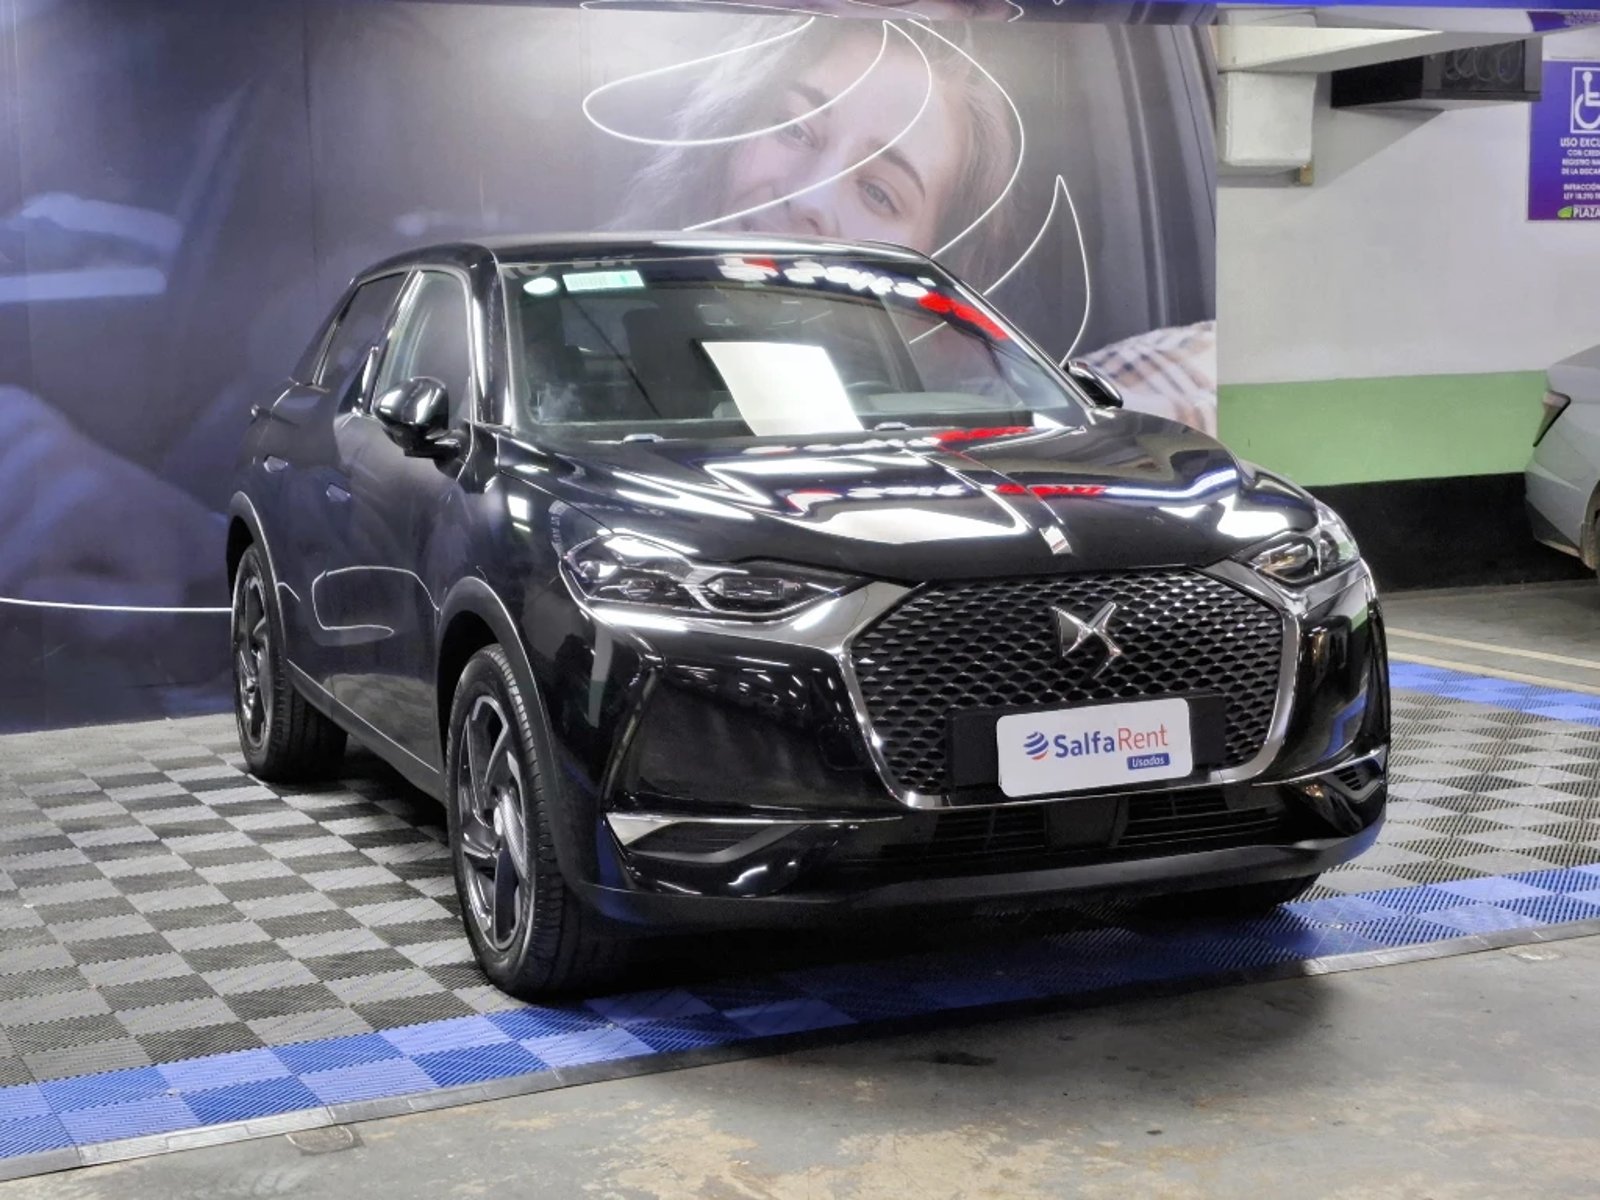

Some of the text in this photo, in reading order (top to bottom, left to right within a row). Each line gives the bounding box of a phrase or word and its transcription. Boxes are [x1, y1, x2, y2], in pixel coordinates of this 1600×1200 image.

[1560, 137, 1578, 147] USO
[1562, 158, 1590, 166] REGISTRO
[1563, 192, 1574, 200] LEY
[1132, 756, 1165, 768] Usados
